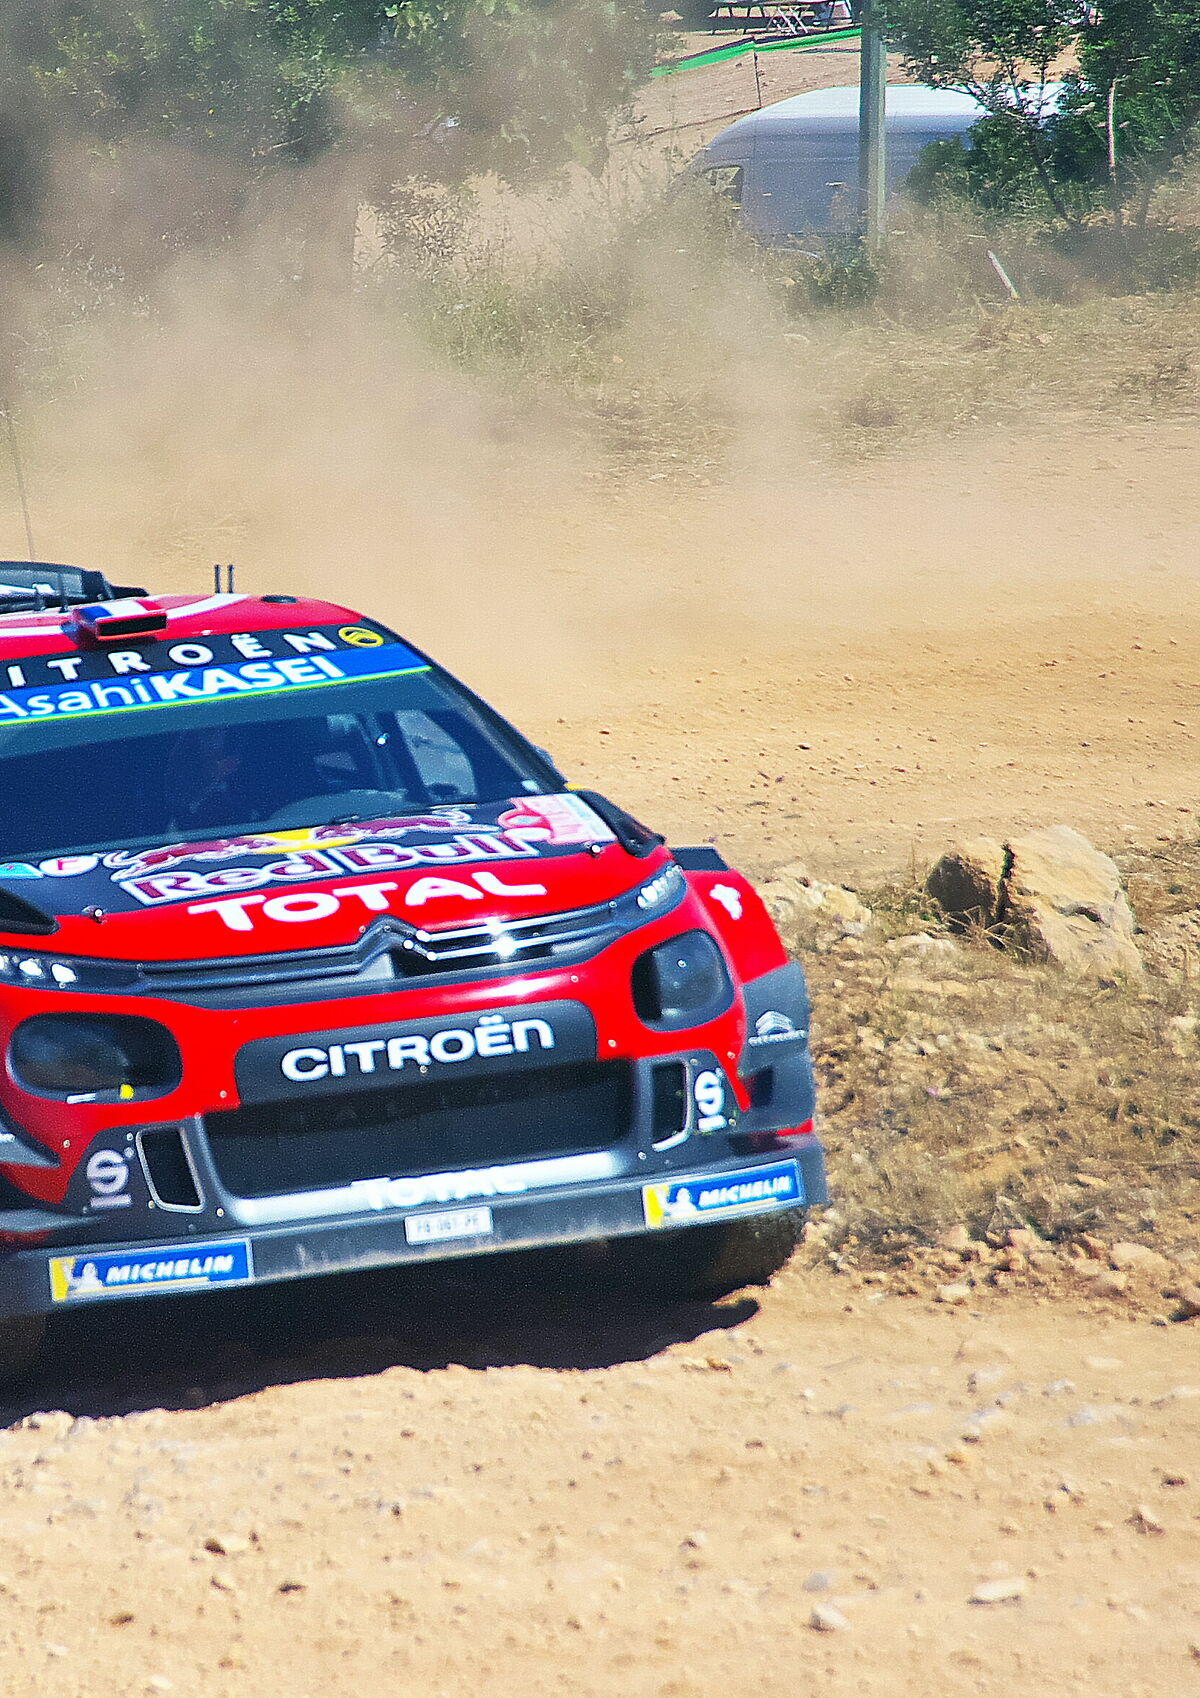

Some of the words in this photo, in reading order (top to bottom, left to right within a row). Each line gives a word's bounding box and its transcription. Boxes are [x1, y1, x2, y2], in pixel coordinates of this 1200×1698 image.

[122, 850, 340, 905] Red
[336, 832, 536, 873] Bull
[187, 870, 547, 931] TOTAL
[350, 1164, 528, 1211] TOTAL
[698, 1176, 791, 1207] MICHELIN
[106, 1254, 235, 1285] MICHELIN
